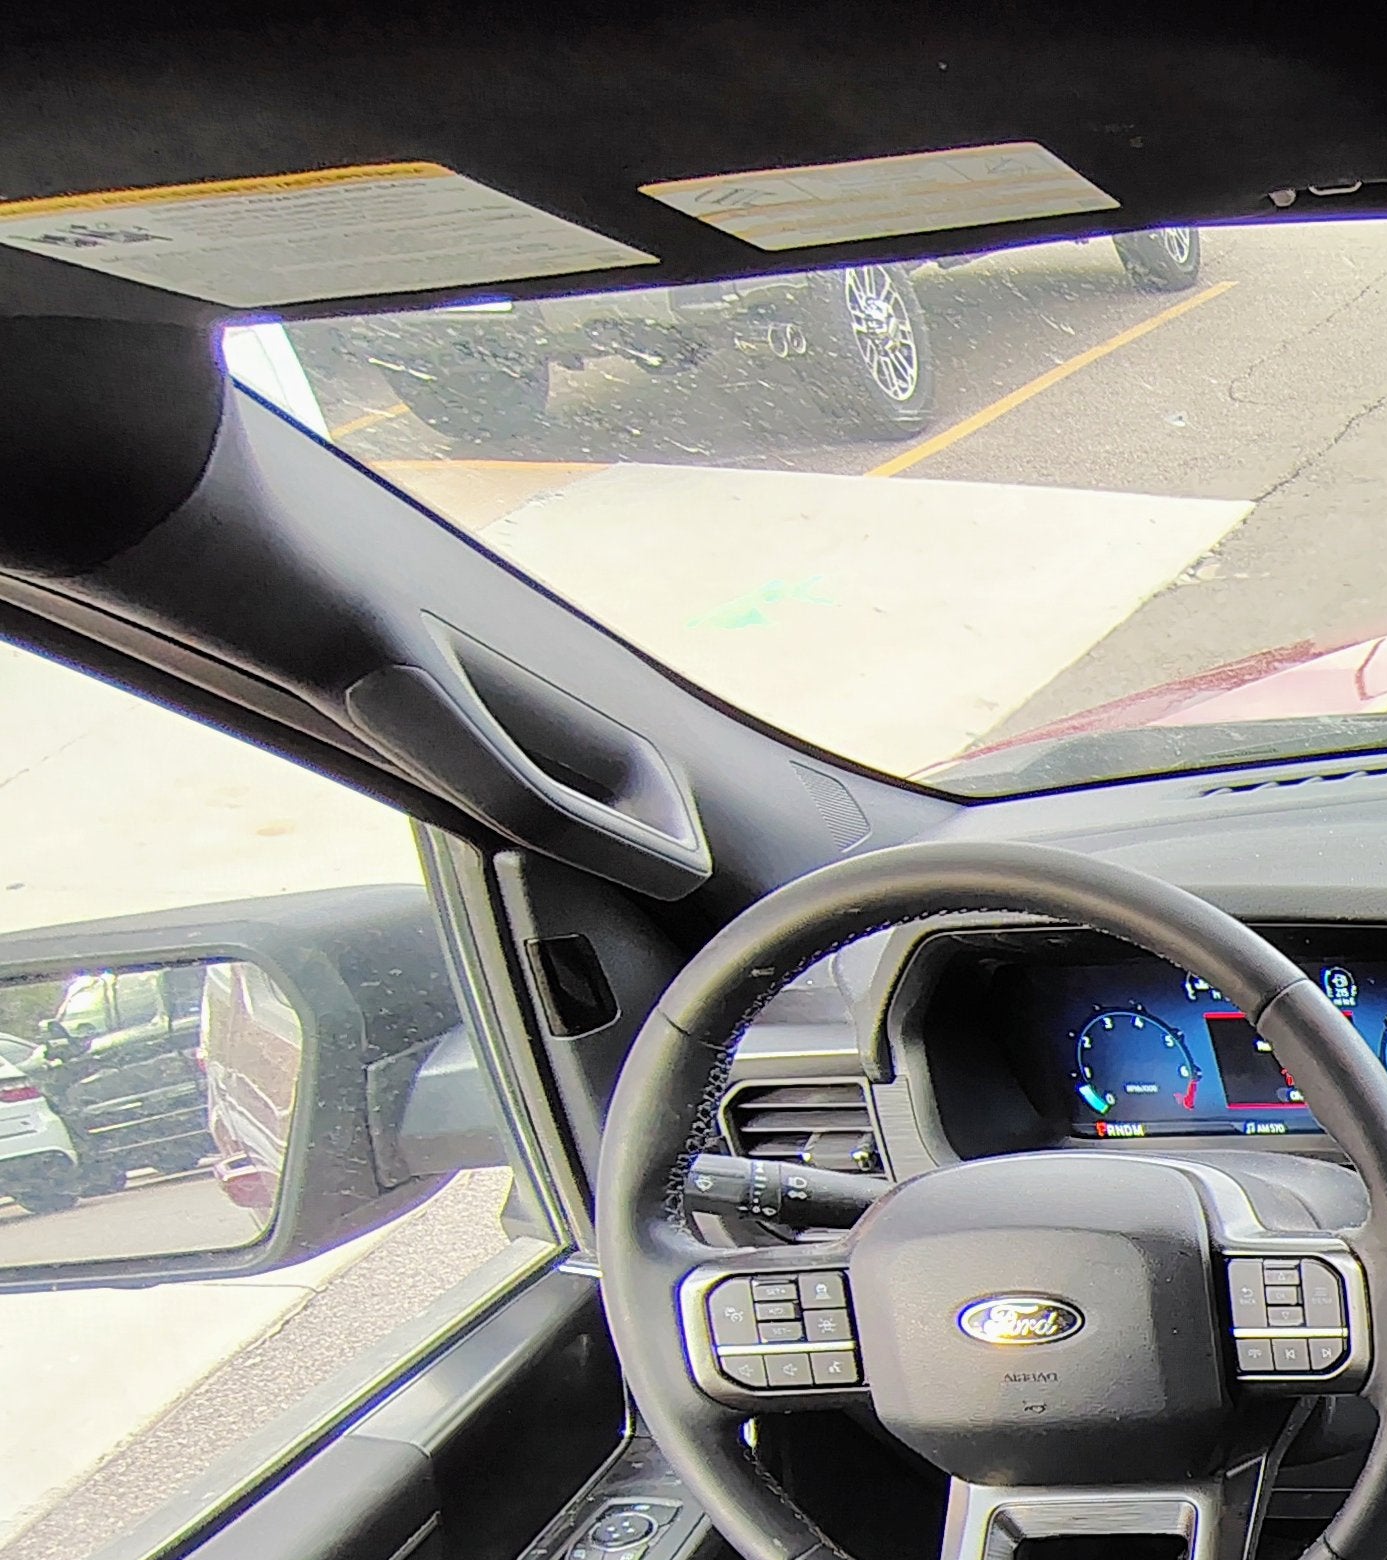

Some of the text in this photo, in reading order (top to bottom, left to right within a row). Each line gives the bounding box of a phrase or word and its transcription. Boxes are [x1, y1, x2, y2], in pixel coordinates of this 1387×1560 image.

[1104, 1017, 1113, 1029] 3
[1134, 1017, 1144, 1028] 4
[1082, 1036, 1092, 1048] 2
[1165, 1035, 1175, 1047] 5
[1180, 1065, 1190, 1077] 6
[1105, 1093, 1115, 1105] 0
[983, 1304, 1058, 1337] Ford
